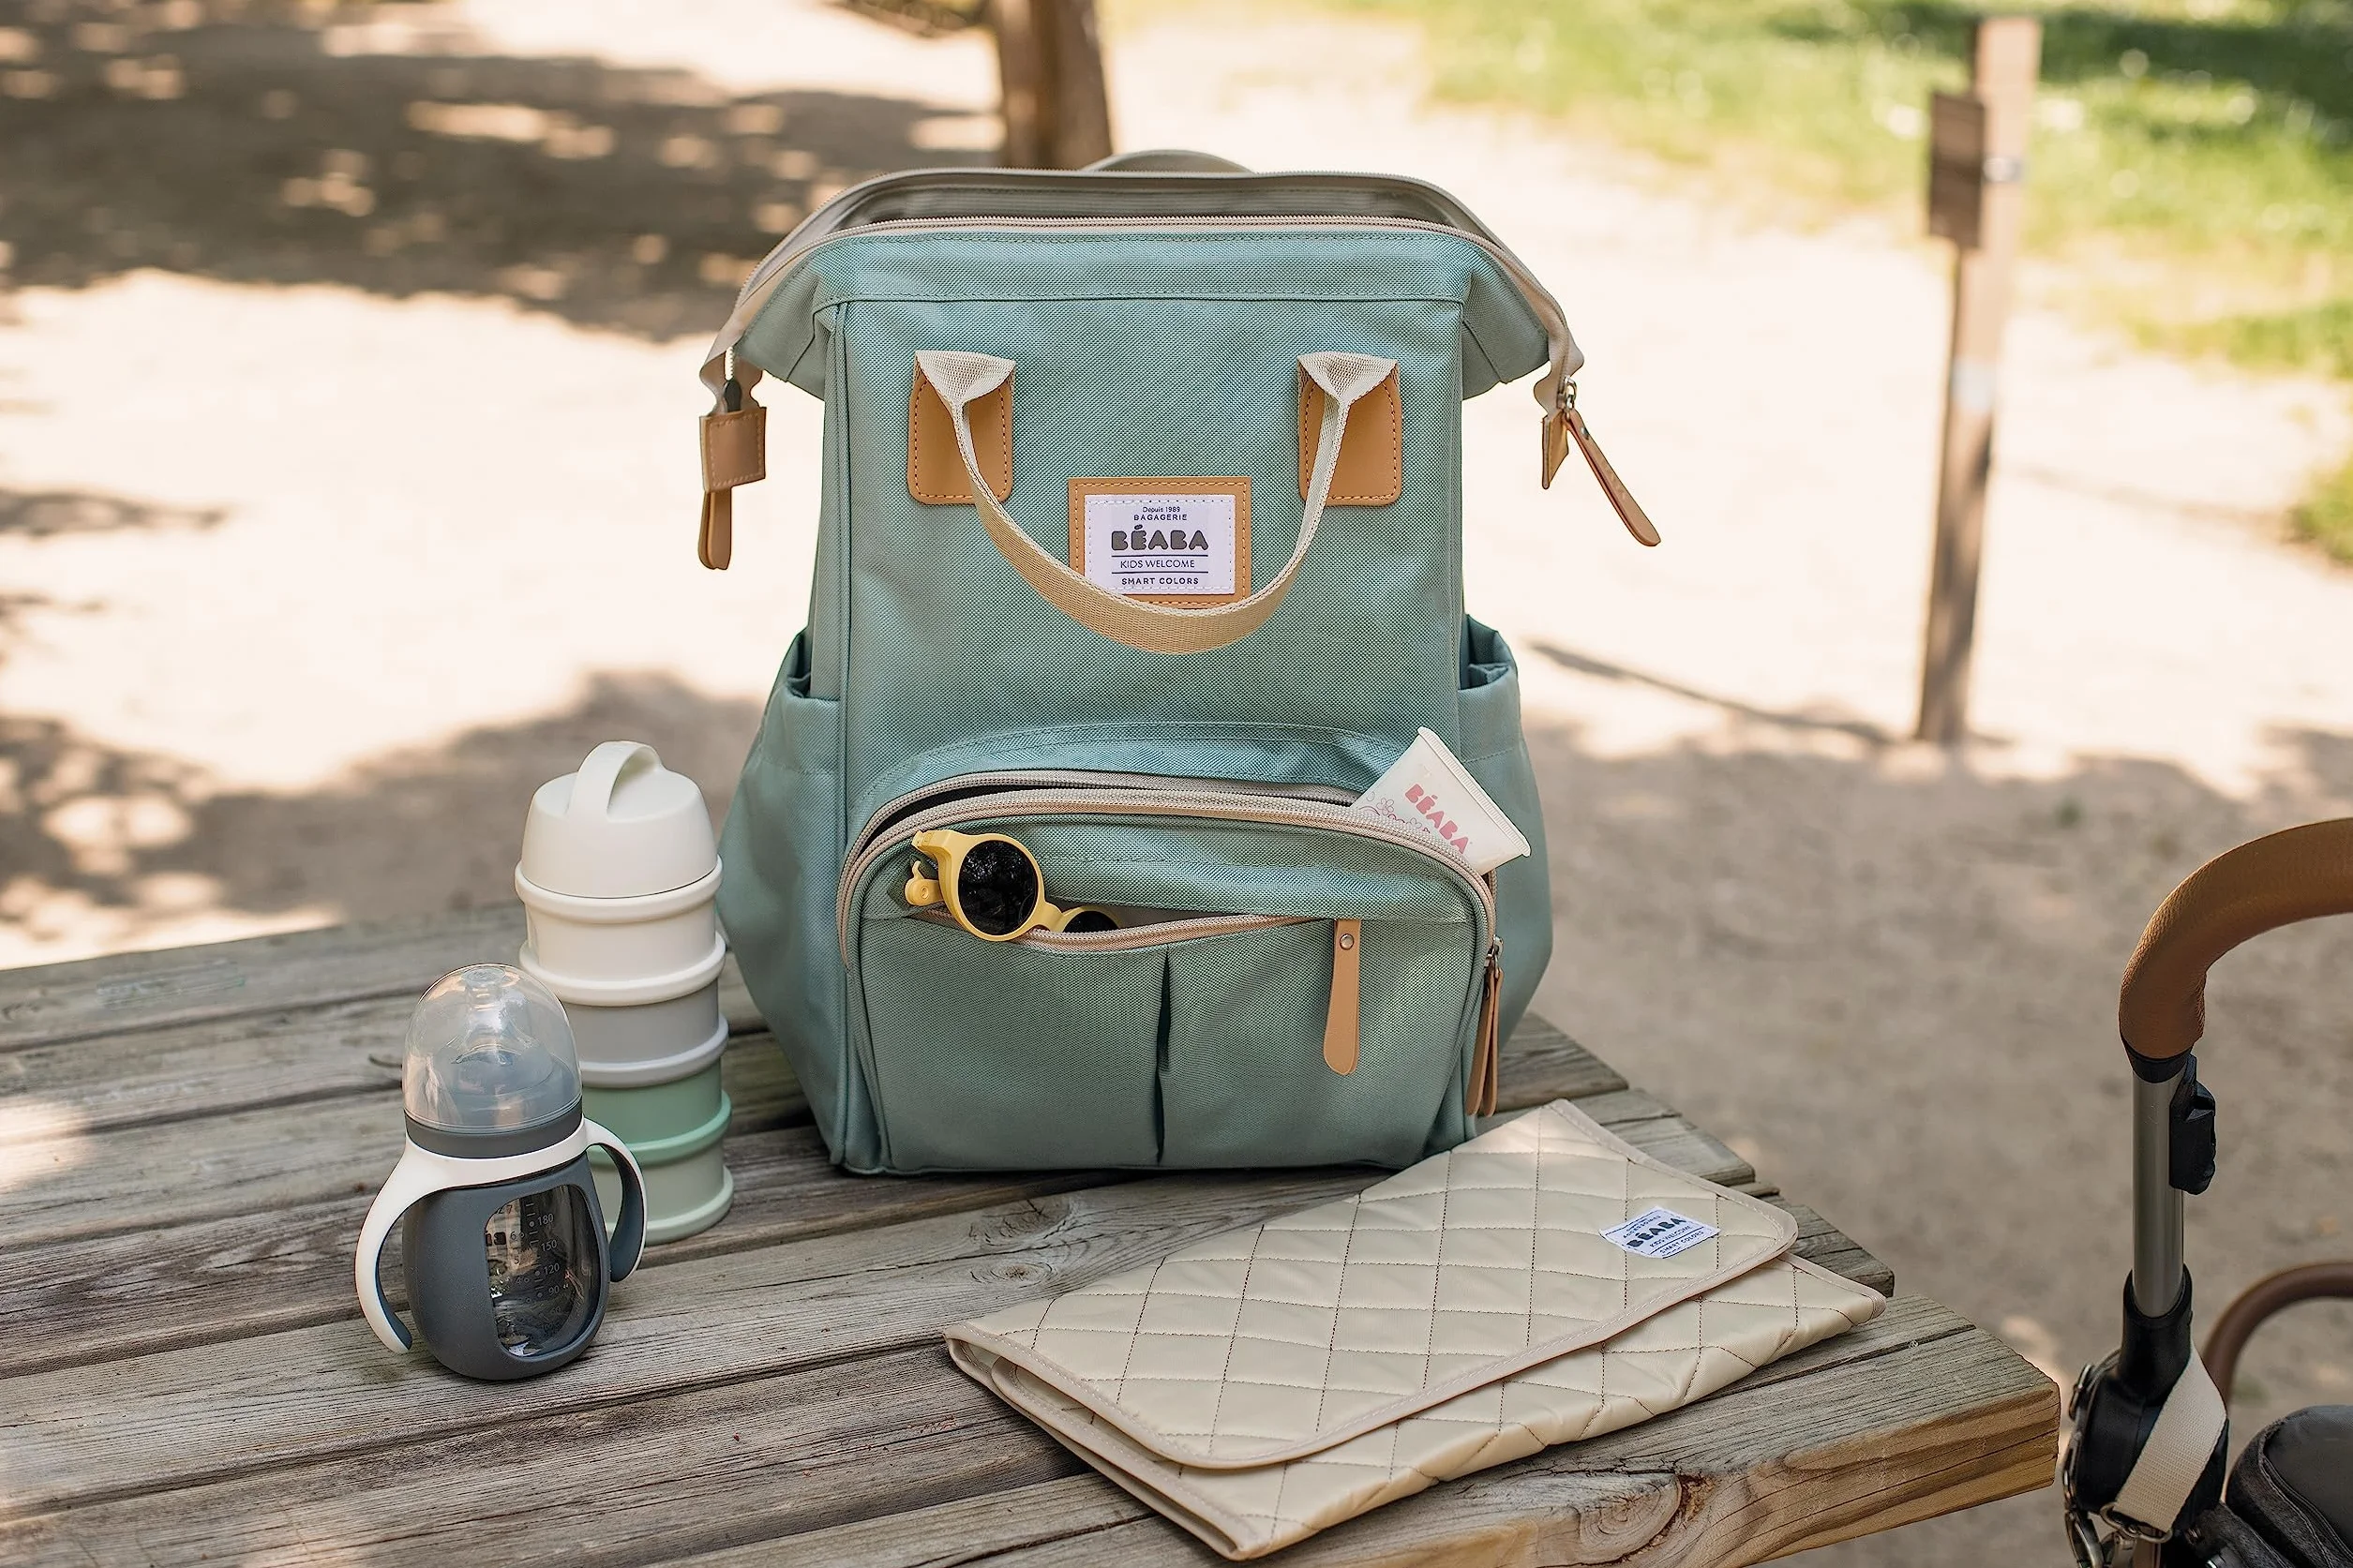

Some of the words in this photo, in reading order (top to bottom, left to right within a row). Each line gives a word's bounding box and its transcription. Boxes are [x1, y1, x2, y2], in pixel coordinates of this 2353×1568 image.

[1111, 524, 1209, 551] BÉABA
[1120, 560, 1144, 569] KIDS
[1146, 560, 1195, 568] WELCOME
[1121, 577, 1156, 586] SMART
[1159, 577, 1199, 586] COLORS
[1404, 783, 1469, 855] BÉABA
[537, 1213, 554, 1226] 180
[1626, 1217, 1686, 1247] BÉABA
[540, 1239, 558, 1252] 150
[543, 1262, 560, 1276] 120
[548, 1285, 560, 1296] 90
